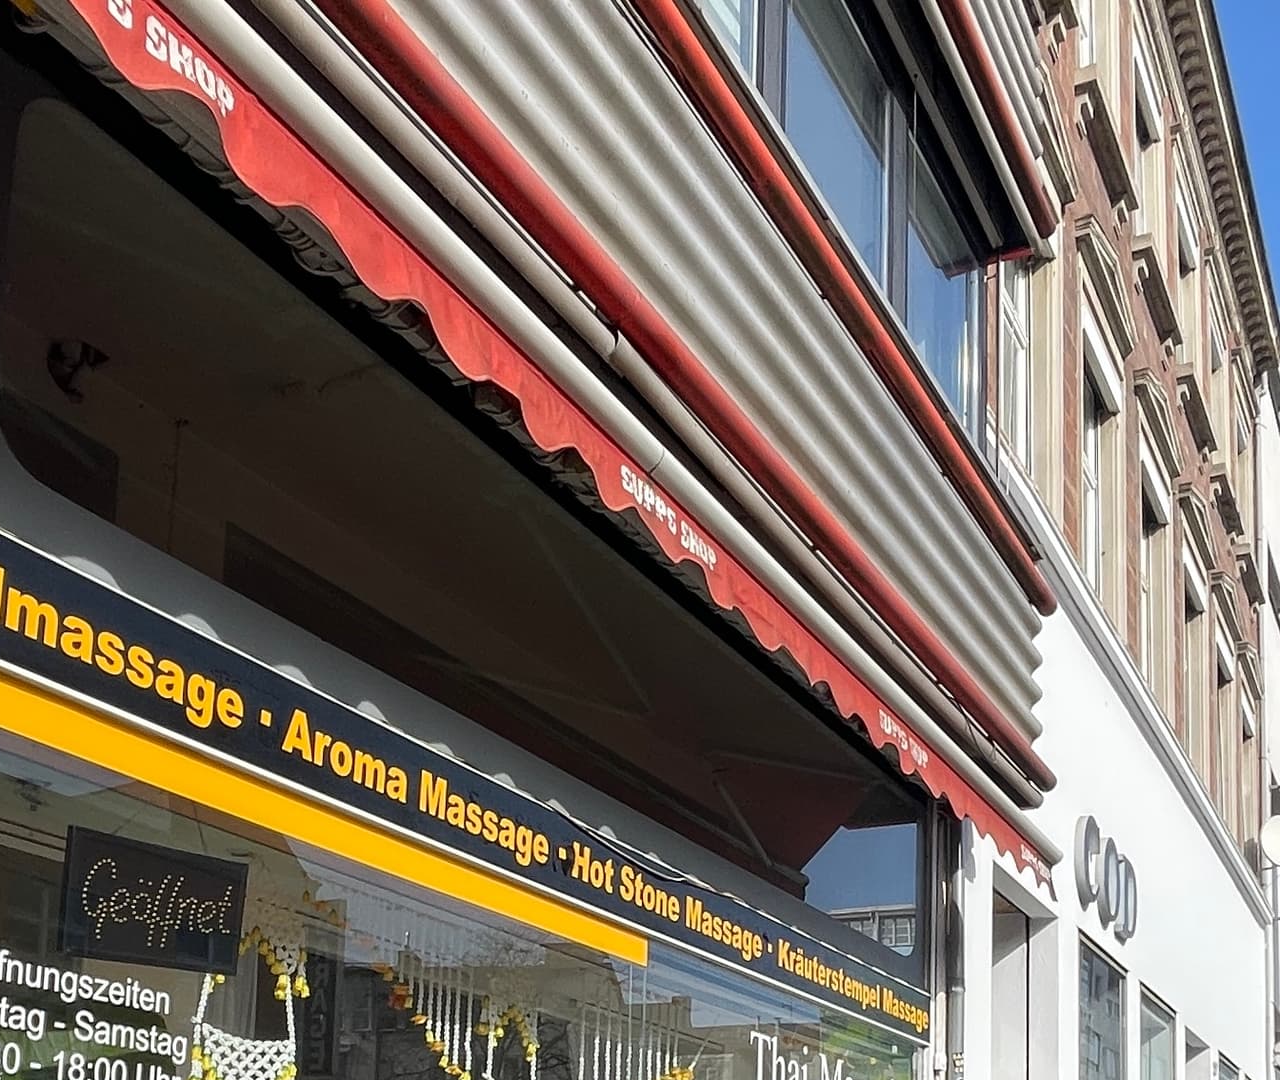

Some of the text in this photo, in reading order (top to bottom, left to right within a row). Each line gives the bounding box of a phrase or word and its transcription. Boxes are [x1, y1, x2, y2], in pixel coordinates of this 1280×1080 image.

[143, 14, 235, 118] SHOP
[680, 519, 718, 572] SHOP
[81, 856, 234, 949] Geöffnet
[280, 708, 408, 805] Aroma
[418, 768, 551, 868] Massage
[570, 840, 615, 895] Hot
[619, 864, 680, 923] Stone
[684, 895, 764, 962] Massage
[777, 938, 881, 1012] Kräuterstempel
[882, 989, 930, 1034] Massage
[73, 1009, 188, 1066] Samstag
